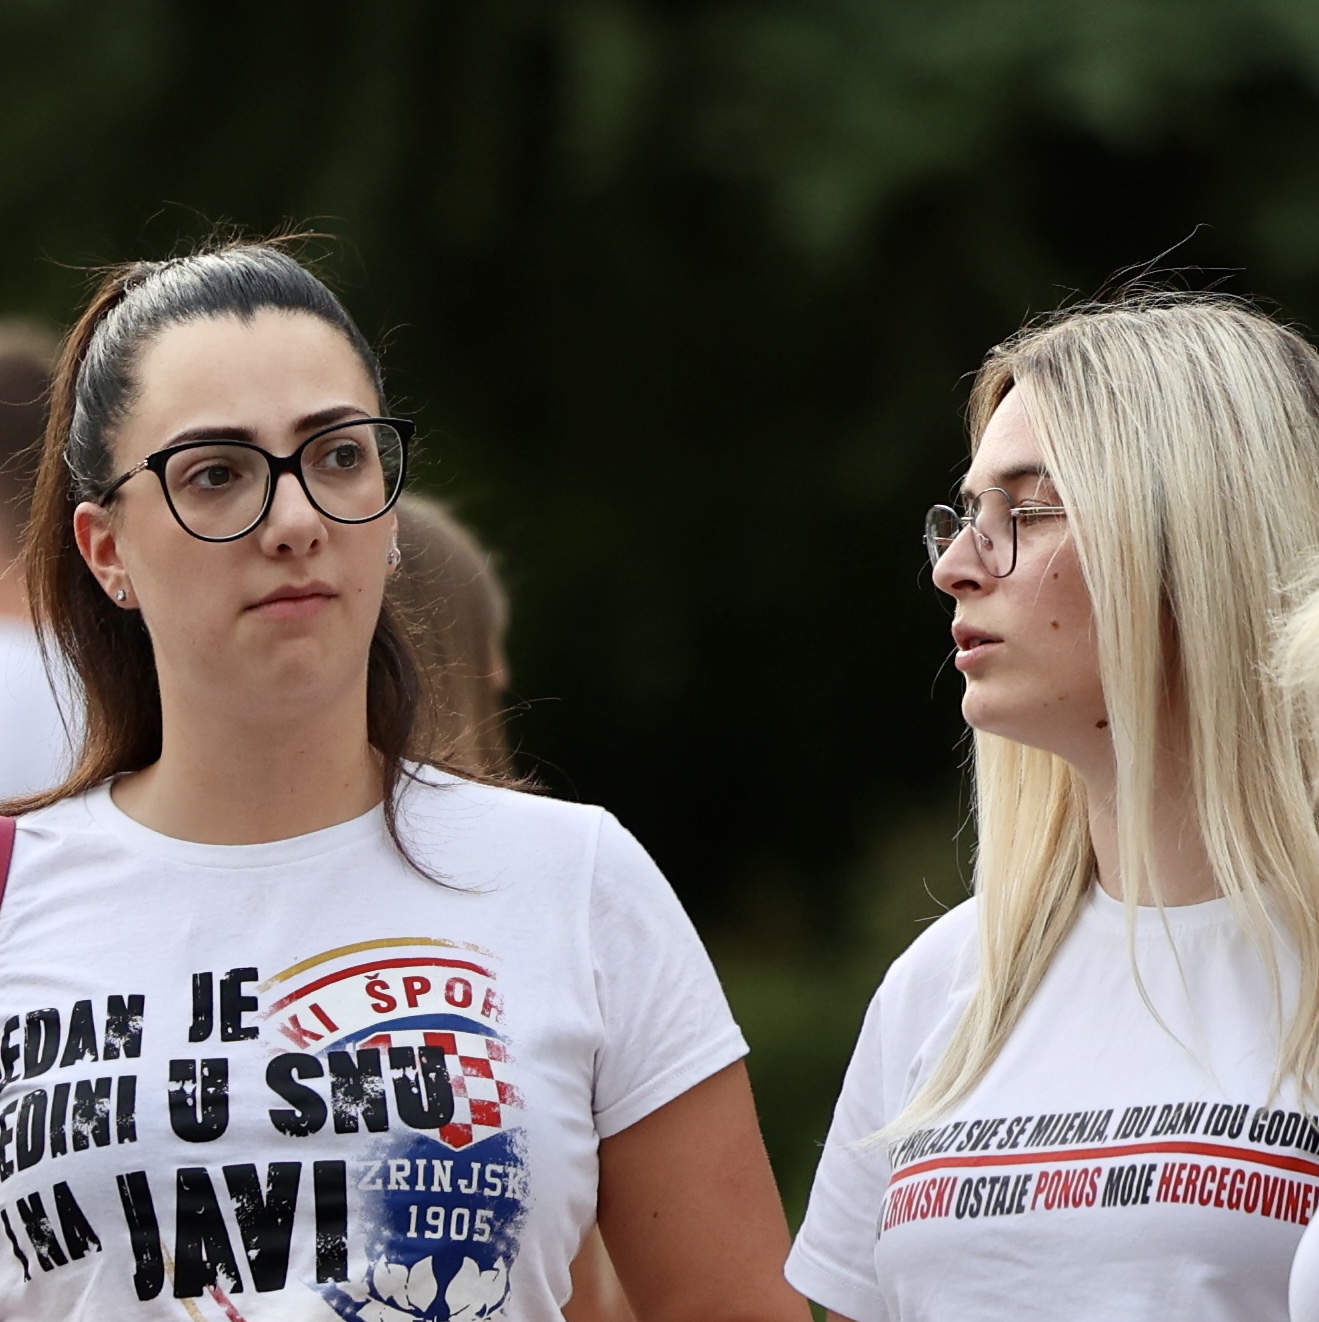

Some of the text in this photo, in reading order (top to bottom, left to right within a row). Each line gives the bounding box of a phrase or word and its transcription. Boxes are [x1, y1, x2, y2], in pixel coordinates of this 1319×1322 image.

[188, 967, 259, 1042] JE
[168, 1058, 229, 1143] U
[265, 1045, 456, 1138] SNU
[956, 1118, 1007, 1152] SVE
[996, 1116, 1033, 1150] SE
[1023, 1109, 1114, 1148] MIJENJA,
[1112, 1105, 1158, 1140] IDU
[1150, 1102, 1208, 1137] DANI
[1202, 1103, 1250, 1139] IDU
[0, 1160, 348, 1301] I NA JAVI
[407, 1205, 494, 1242] 1905
[883, 1176, 958, 1232] ZRINJSKI
[955, 1174, 1033, 1219] OSTAJE
[1030, 1167, 1102, 1211] PONOS
[1101, 1164, 1157, 1208] MOJE
